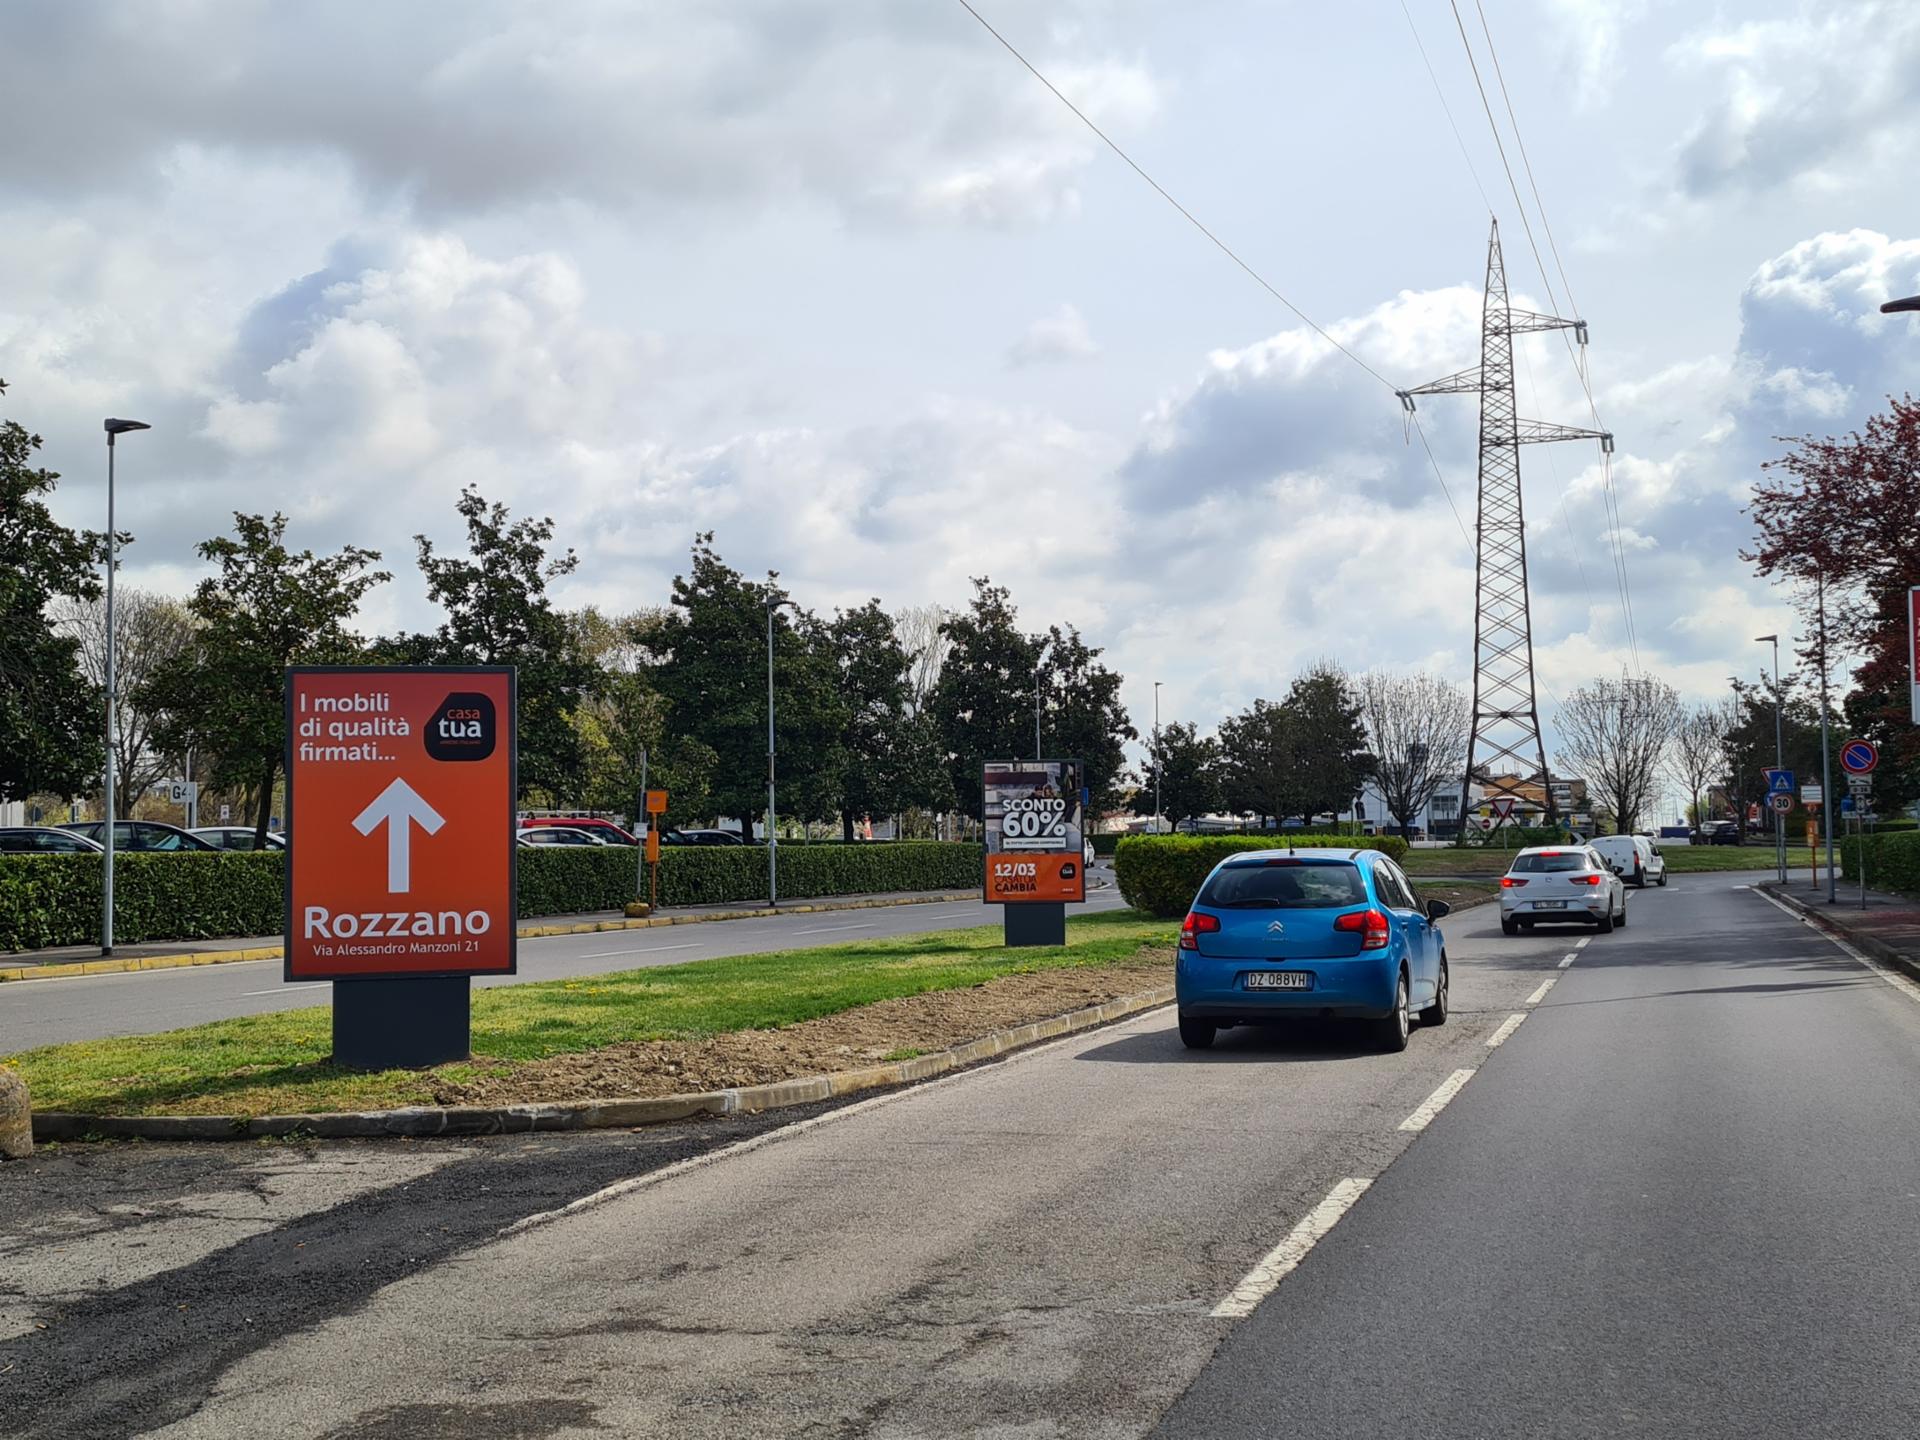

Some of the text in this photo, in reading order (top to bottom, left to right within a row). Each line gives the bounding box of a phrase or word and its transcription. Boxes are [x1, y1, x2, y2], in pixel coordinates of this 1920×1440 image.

[300, 693, 389, 713] I mobili
[447, 708, 480, 720] casa
[299, 717, 410, 742] di qualità
[438, 717, 482, 738] tua
[299, 742, 396, 761] firmati...
[1002, 799, 1066, 812] SCONTO
[1776, 798, 1789, 809] 30
[1002, 811, 1067, 837] 60%
[994, 863, 1036, 877] 12/03
[994, 883, 1037, 892] CAMBIA
[304, 906, 490, 939] Rozzano
[313, 941, 479, 956] Via Alessandro Manzoni 21
[1250, 973, 1305, 986] DZ 088VH
